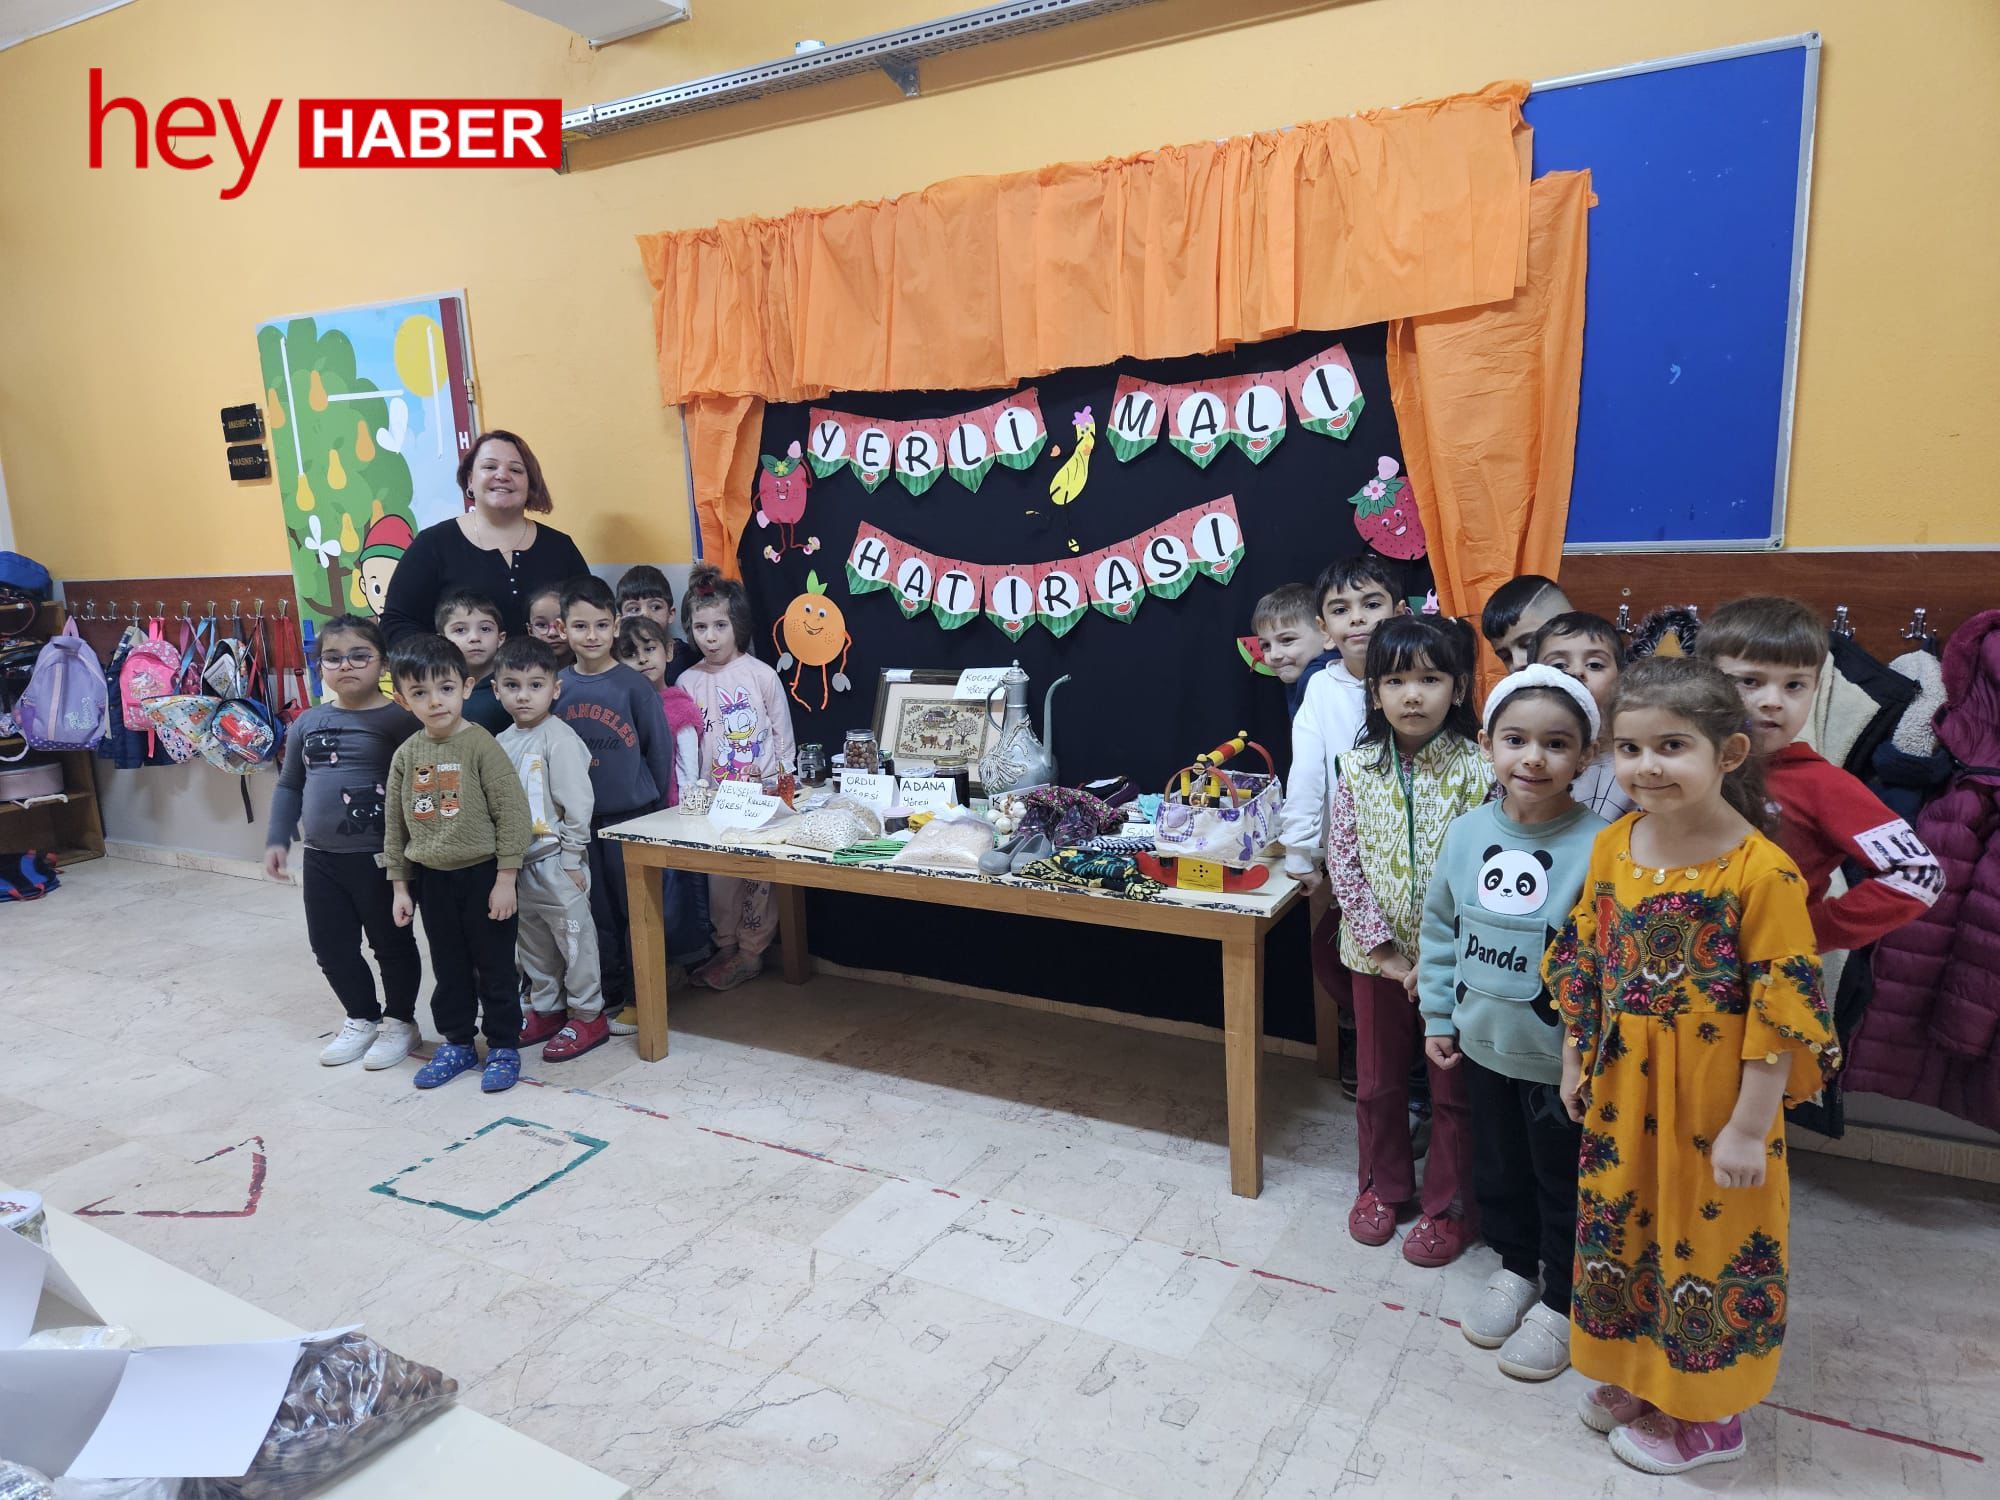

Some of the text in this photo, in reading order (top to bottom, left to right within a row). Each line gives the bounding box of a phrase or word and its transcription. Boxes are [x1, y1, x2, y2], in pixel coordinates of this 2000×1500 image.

[821, 368, 1338, 473] YERLİ MALI
[857, 517, 1226, 616] HATIRASI
[565, 703, 637, 748] ANGELES
[846, 776, 876, 786] ORDU
[902, 780, 946, 792] ADANA
[1465, 933, 1528, 973] Panda
